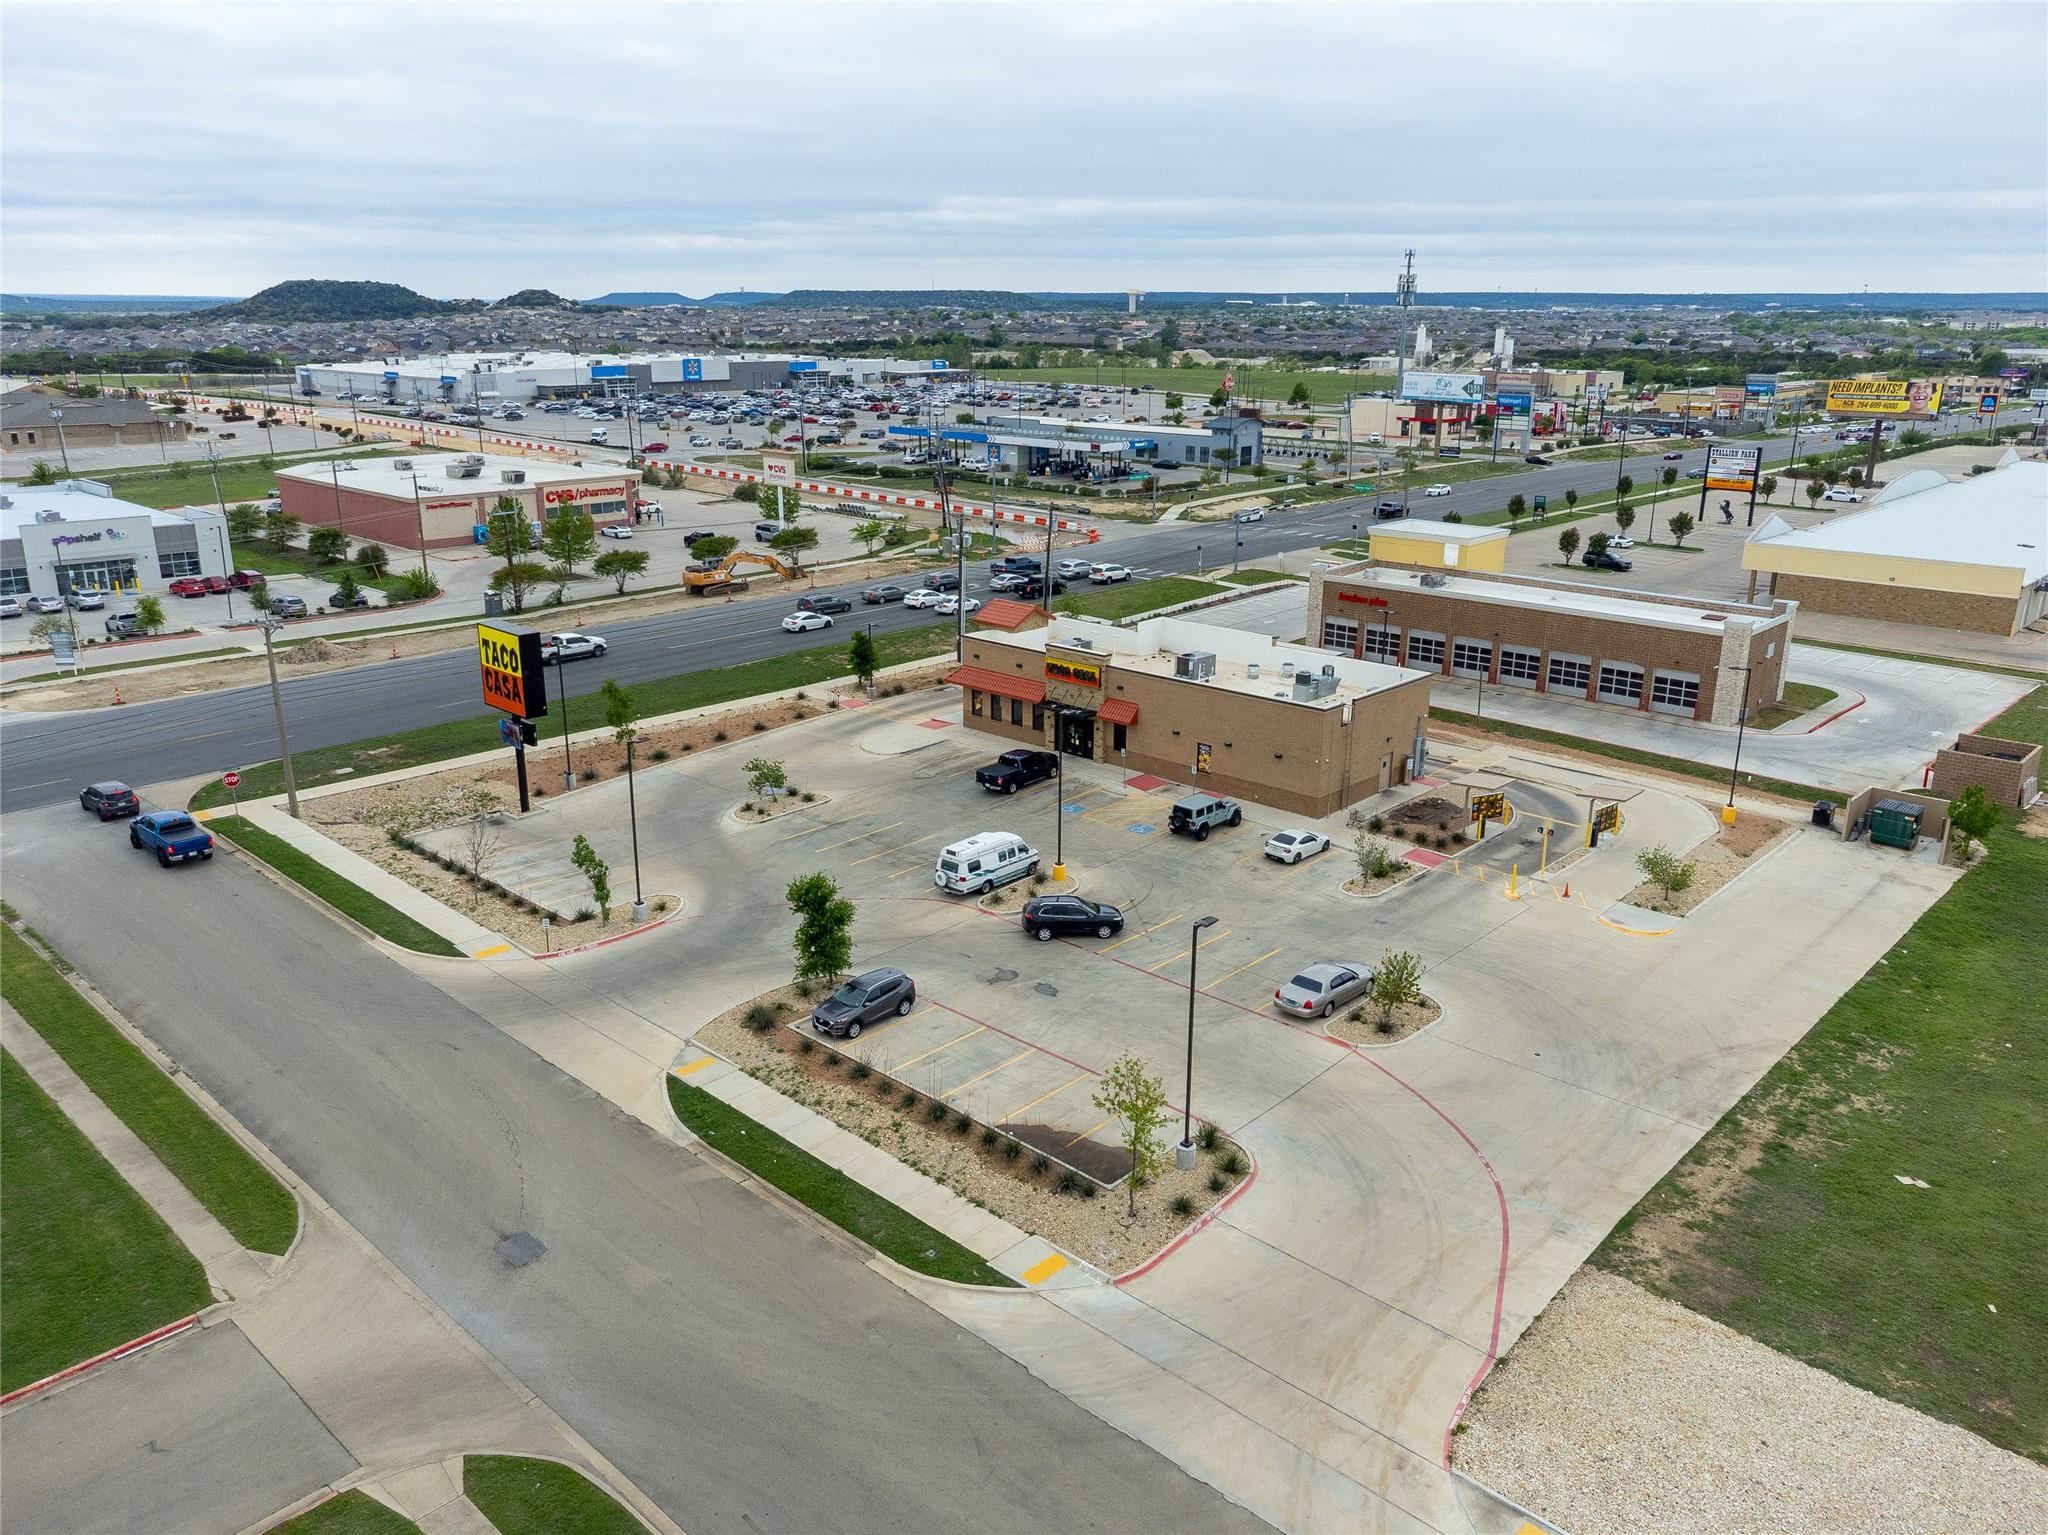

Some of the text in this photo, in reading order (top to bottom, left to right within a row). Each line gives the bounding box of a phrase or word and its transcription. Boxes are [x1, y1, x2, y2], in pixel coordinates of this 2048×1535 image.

[1830, 381, 1902, 394] NEED IMPLANTS?
[1711, 448, 1757, 459] STALLION PARK
[773, 465, 787, 474] CVS
[52, 532, 102, 546] popshelf
[481, 637, 520, 674] TACO
[484, 667, 523, 705] CASA
[224, 775, 240, 784] STOP
